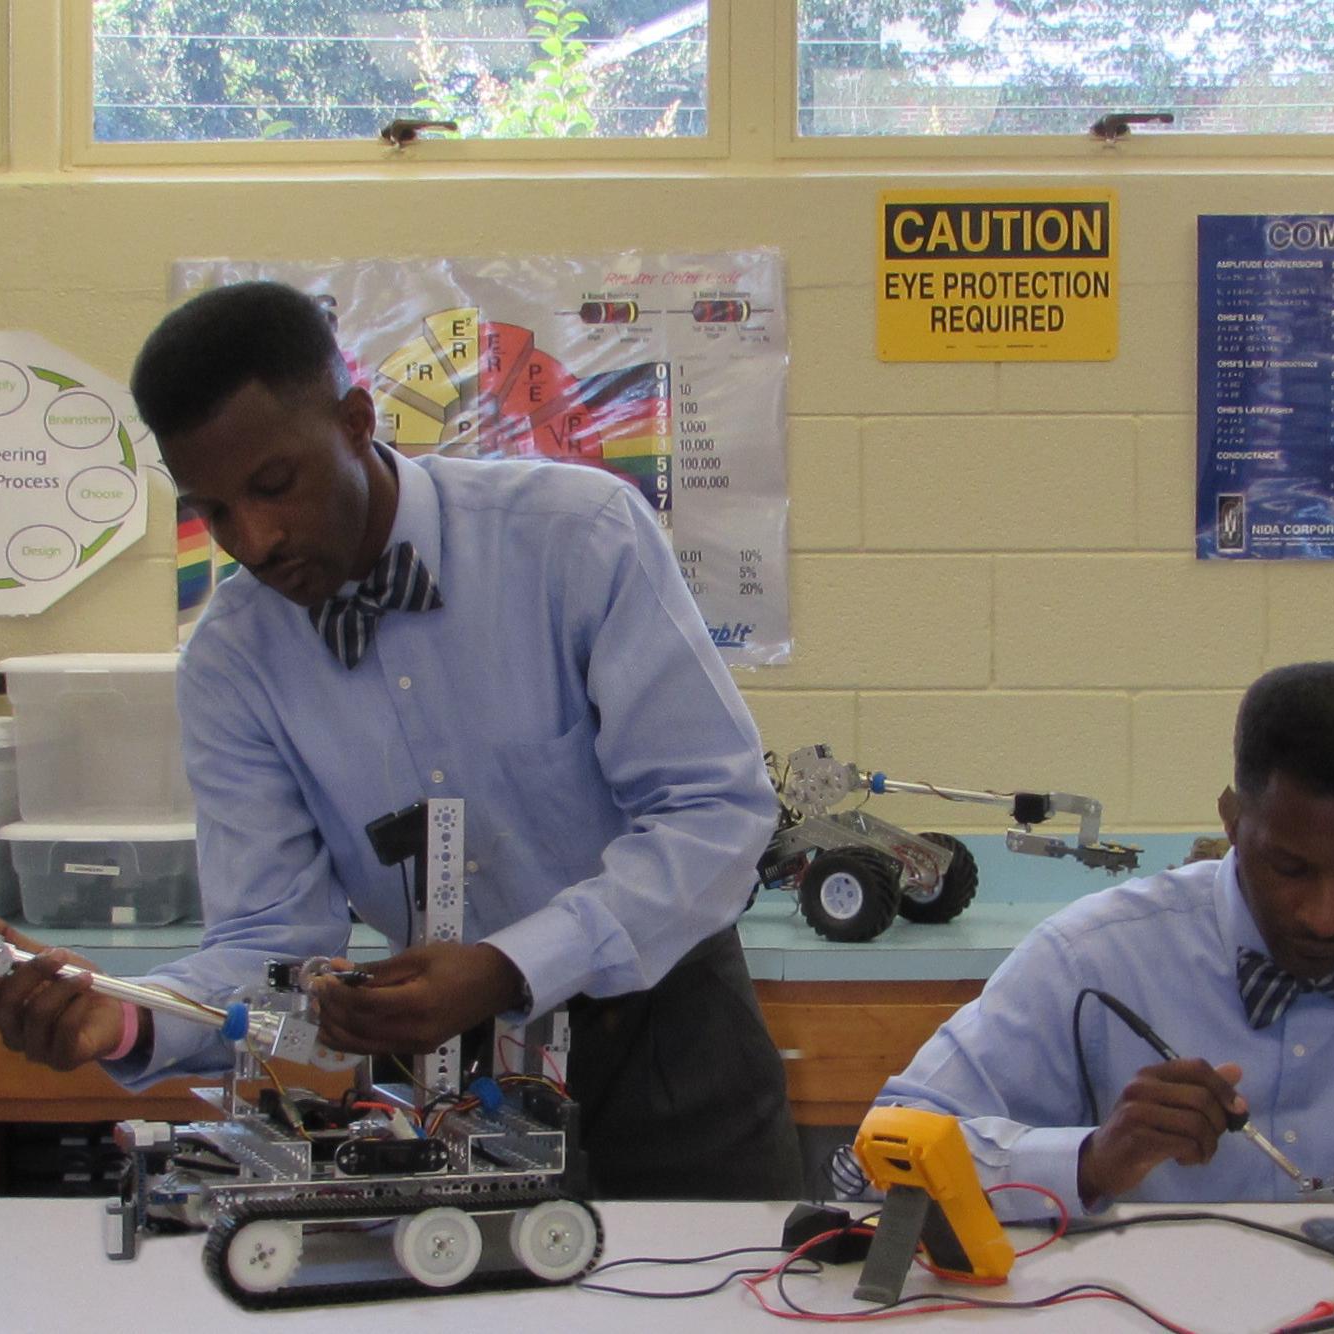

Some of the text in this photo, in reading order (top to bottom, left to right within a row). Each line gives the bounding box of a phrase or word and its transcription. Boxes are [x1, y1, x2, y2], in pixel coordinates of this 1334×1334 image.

[893, 209, 1102, 253] CAUTION
[1217, 260, 1324, 269] AMPLITUDE CONVERSIONS
[885, 270, 1110, 299] EYE PROTECTION
[931, 304, 1065, 333] REQUIRED
[1245, 313, 1265, 322] LAW
[452, 341, 467, 359] R
[655, 363, 667, 379] 0
[1245, 360, 1264, 368] LAW
[529, 364, 543, 380] P
[530, 385, 542, 402] E
[657, 382, 667, 397] 1
[656, 400, 667, 416] 2
[680, 402, 698, 415] 100
[1245, 406, 1264, 414] LAW
[48, 414, 111, 425] Brainstorm
[656, 419, 667, 435] 3
[680, 421, 706, 435] 1,000
[680, 439, 715, 453] 10,000
[1217, 451, 1280, 460] CONDUCTANCE
[656, 457, 667, 472] 5
[680, 457, 721, 471] 100,000
[656, 476, 668, 491] 6
[680, 475, 730, 490] 1,000,000
[80, 488, 123, 500] Choose
[656, 493, 668, 509] 7
[1252, 524, 1280, 535] NIDA
[22, 545, 61, 560] Design
[680, 550, 702, 563] 0.01
[739, 550, 762, 563] 10%
[739, 566, 757, 579] 5%
[739, 582, 764, 595] 20%
